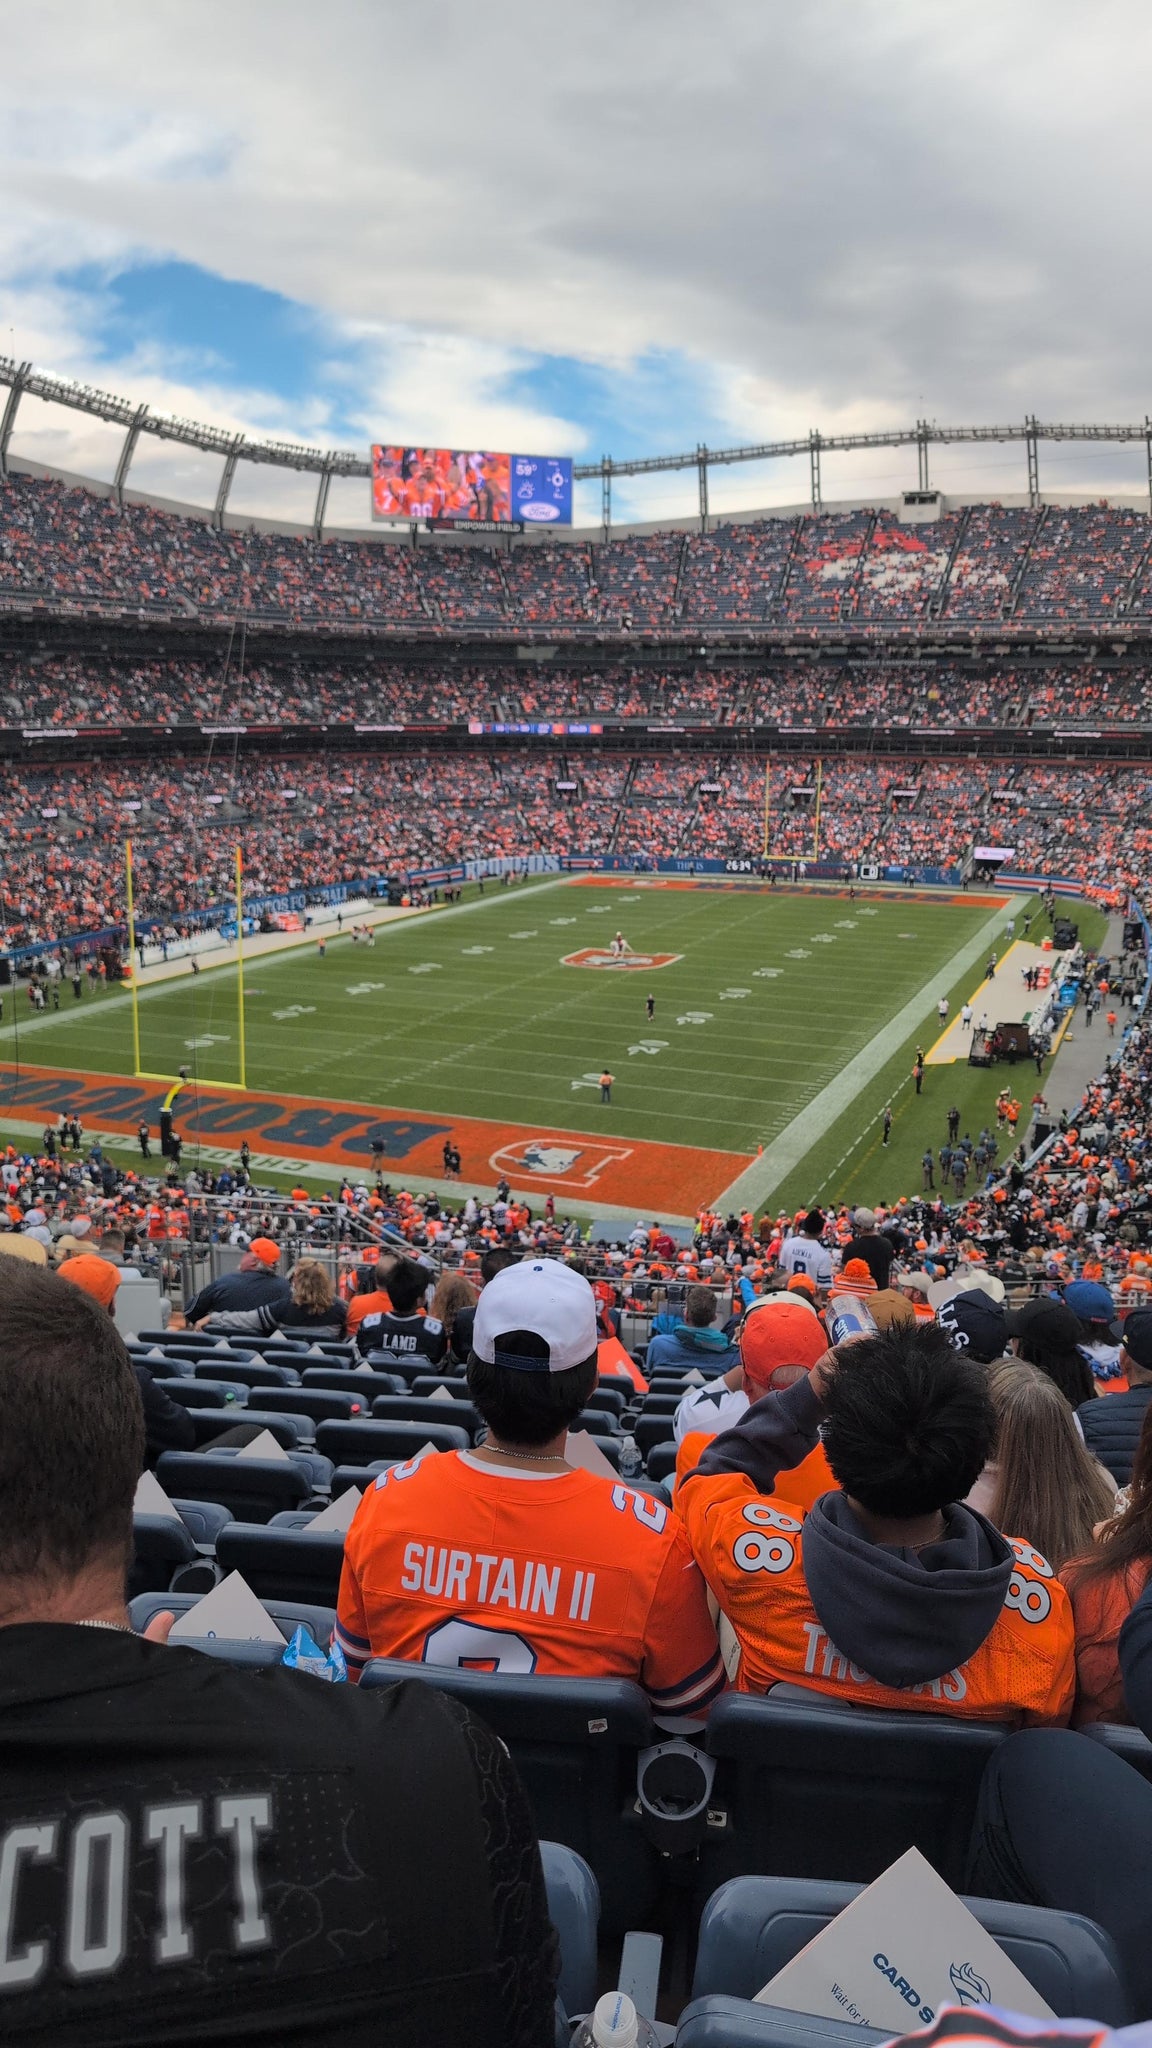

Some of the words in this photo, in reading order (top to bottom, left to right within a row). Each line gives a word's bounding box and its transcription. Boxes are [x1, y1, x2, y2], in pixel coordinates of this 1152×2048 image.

[454, 521, 496, 531] EMPOWER
[497, 522, 521, 533] FIELD
[382, 1333, 417, 1352] LAMB
[401, 1541, 561, 1616] SURTAIN
[568, 1570, 596, 1622] II
[803, 1621, 968, 1701] THAS
[0, 1796, 270, 1984] COTT
[830, 1982, 849, 2007] Wait
[846, 2003, 861, 2021] for
[873, 1953, 921, 2008] CARD
